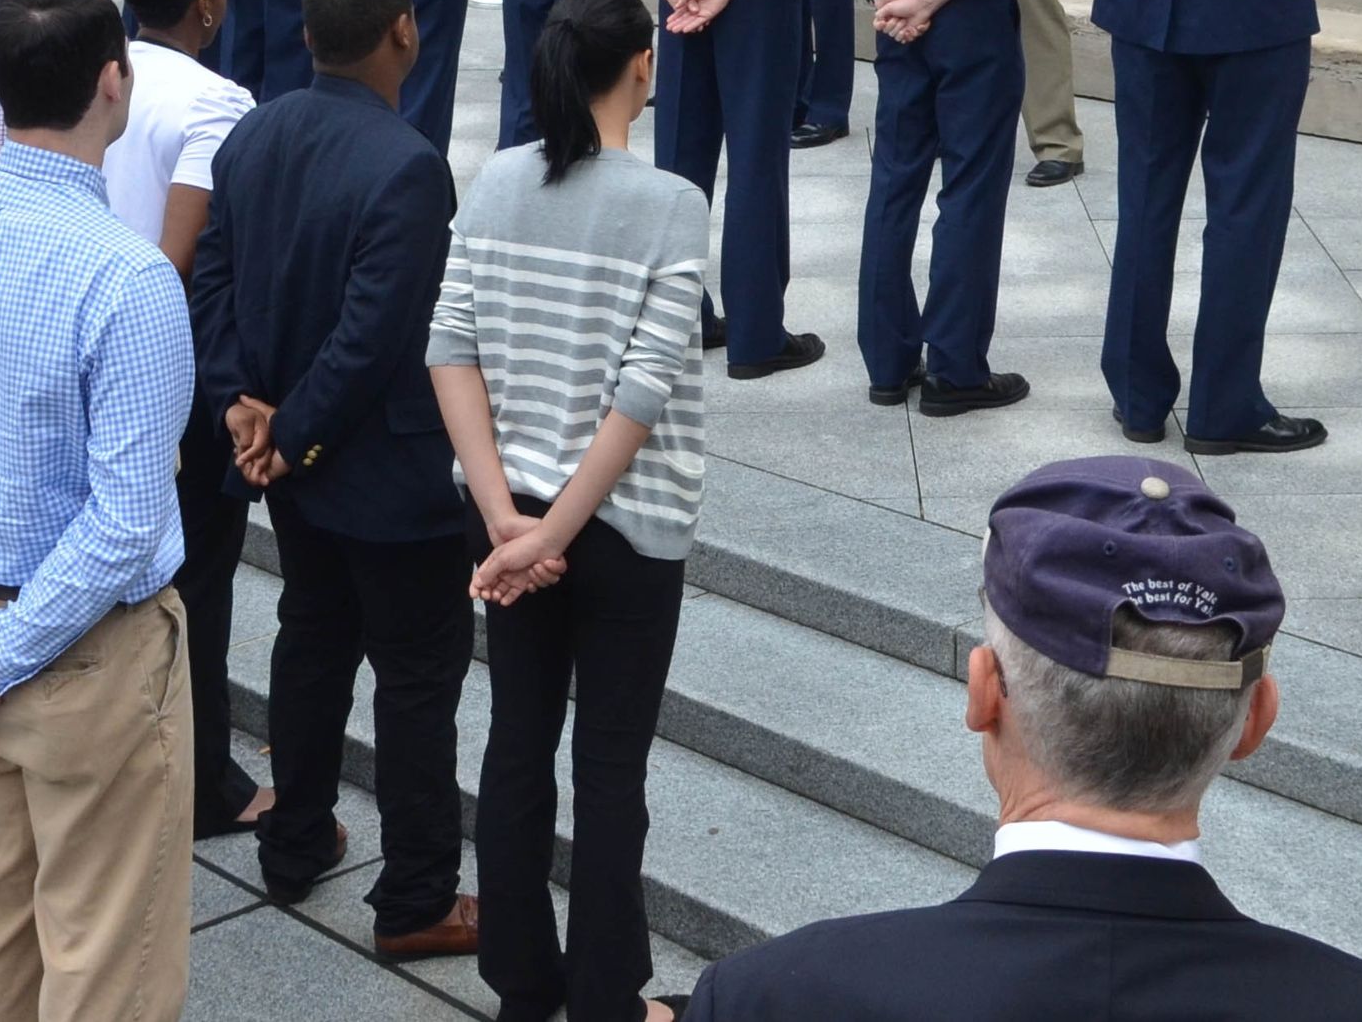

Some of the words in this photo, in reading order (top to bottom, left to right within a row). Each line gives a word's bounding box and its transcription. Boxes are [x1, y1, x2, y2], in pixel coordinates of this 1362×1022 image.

[1122, 581, 1145, 594] The
[1148, 578, 1174, 590] best
[1178, 582, 1193, 592] of
[1195, 584, 1218, 605] Yale
[1129, 596, 1144, 606] he
[1145, 592, 1170, 603] best
[1173, 592, 1193, 605] for
